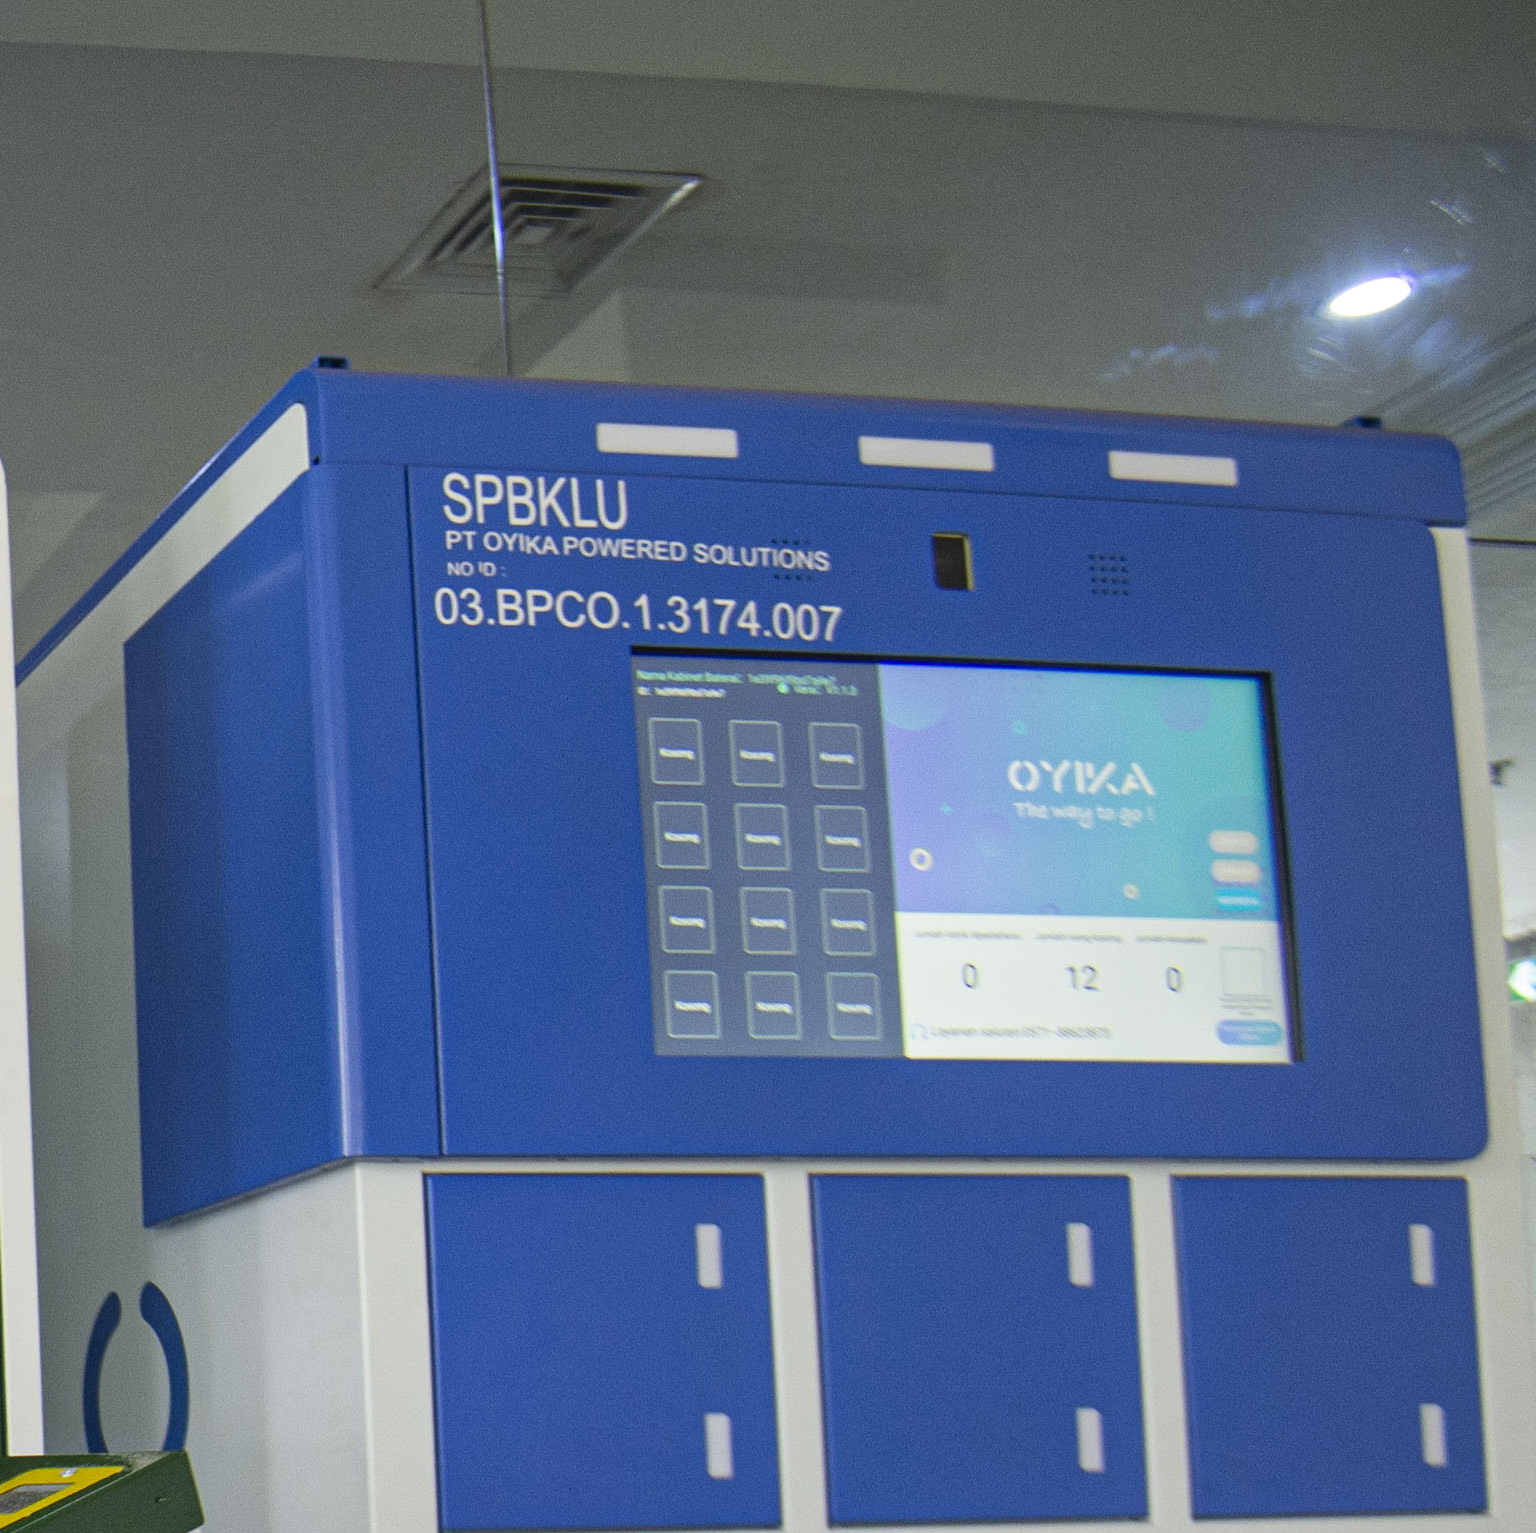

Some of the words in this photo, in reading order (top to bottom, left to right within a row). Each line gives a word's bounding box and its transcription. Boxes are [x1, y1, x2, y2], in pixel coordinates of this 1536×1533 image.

[442, 472, 627, 530] SPBKLU
[445, 530, 476, 551] PT
[483, 531, 559, 556] OYIKA
[563, 536, 687, 562] POWERED
[693, 543, 830, 572] SOLUTIONS
[446, 562, 474, 576] NO
[434, 587, 843, 642] 03.BPCO.1.3174.007
[1007, 758, 1155, 796] OYIKA
[961, 962, 978, 989] 0
[1066, 964, 1099, 991] 12
[1165, 966, 1182, 992] 0
